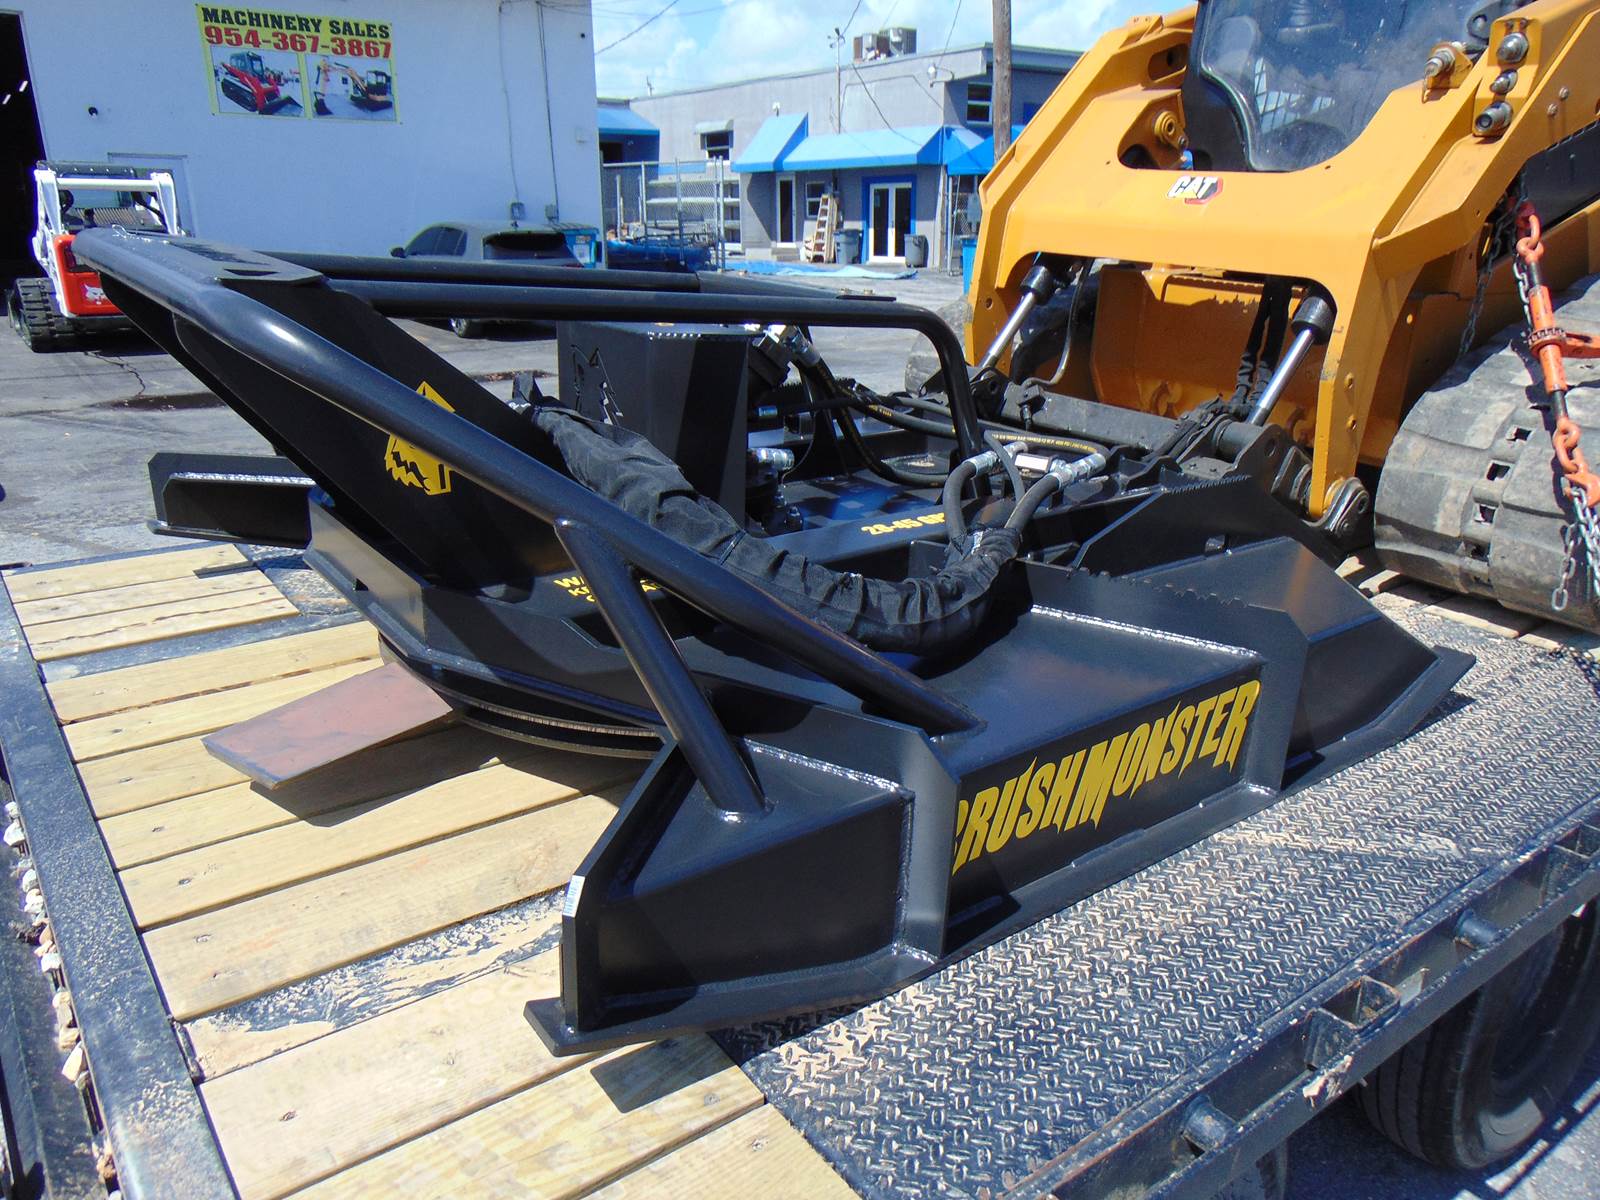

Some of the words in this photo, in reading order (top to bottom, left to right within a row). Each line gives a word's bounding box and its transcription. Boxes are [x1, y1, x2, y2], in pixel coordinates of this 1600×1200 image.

[201, 7, 323, 33] MACHINERY
[329, 19, 391, 39] SALES
[204, 25, 393, 59] 954-367-3867
[1167, 175, 1219, 200] CAT
[952, 679, 1261, 876] RUSHMONSTER
